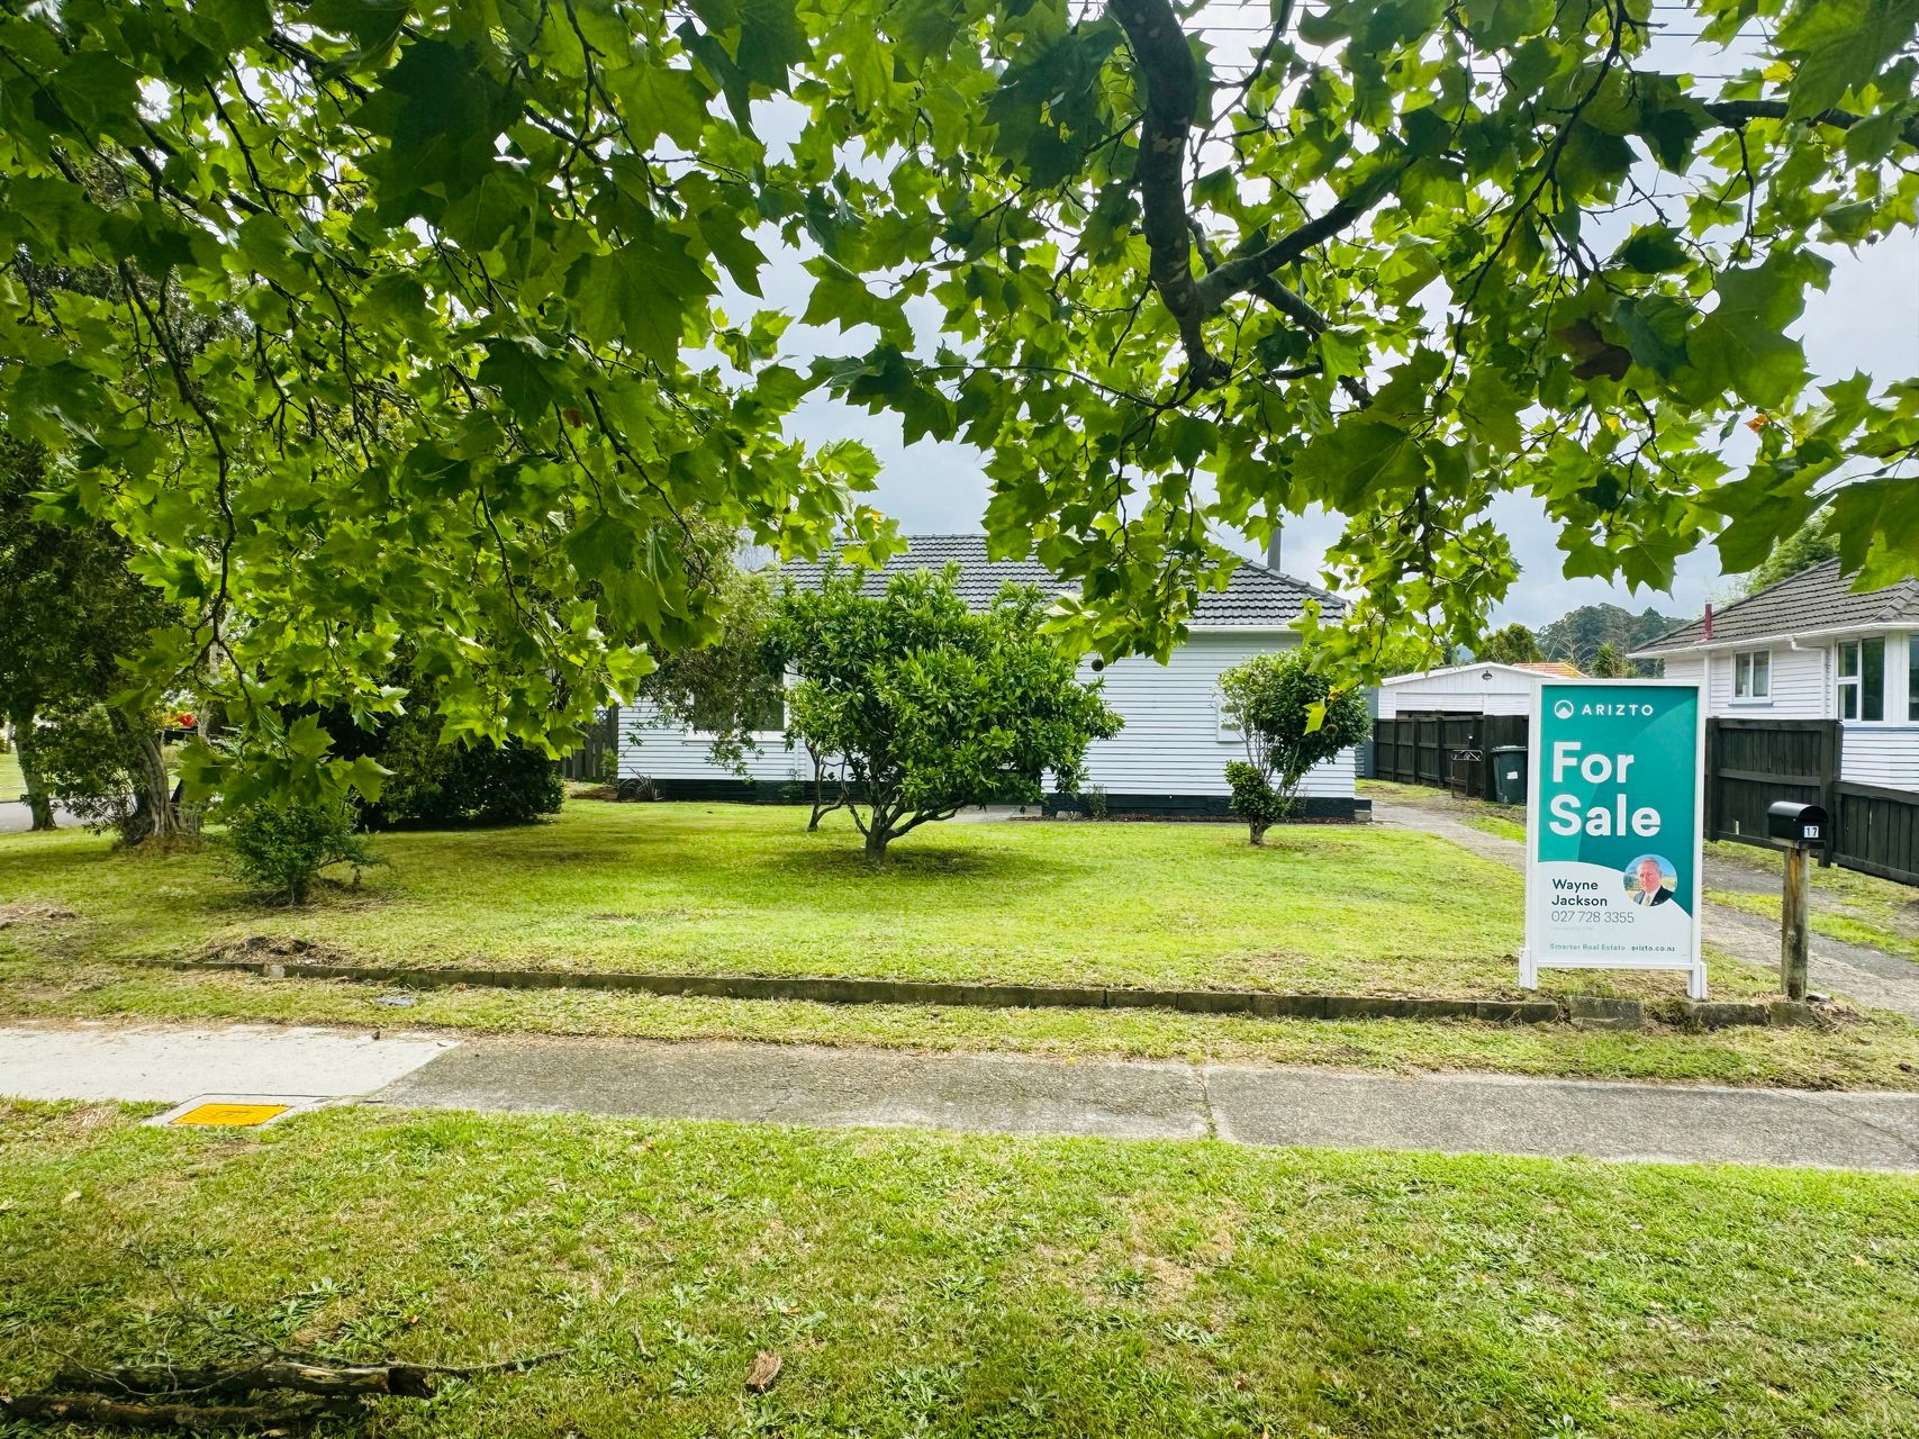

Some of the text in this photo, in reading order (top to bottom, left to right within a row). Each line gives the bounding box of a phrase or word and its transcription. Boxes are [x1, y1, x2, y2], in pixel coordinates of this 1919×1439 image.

[1581, 703, 1654, 717] ARIZTO
[1552, 741, 1635, 784] For
[1549, 793, 1661, 838] Sale
[1806, 826, 1818, 837] 17
[1552, 878, 1599, 894] Wayne
[1551, 894, 1608, 907] Jackson
[1551, 910, 1635, 924] 027 728 3355
[1582, 943, 1600, 951] Real
[1601, 943, 1626, 951] Estate
